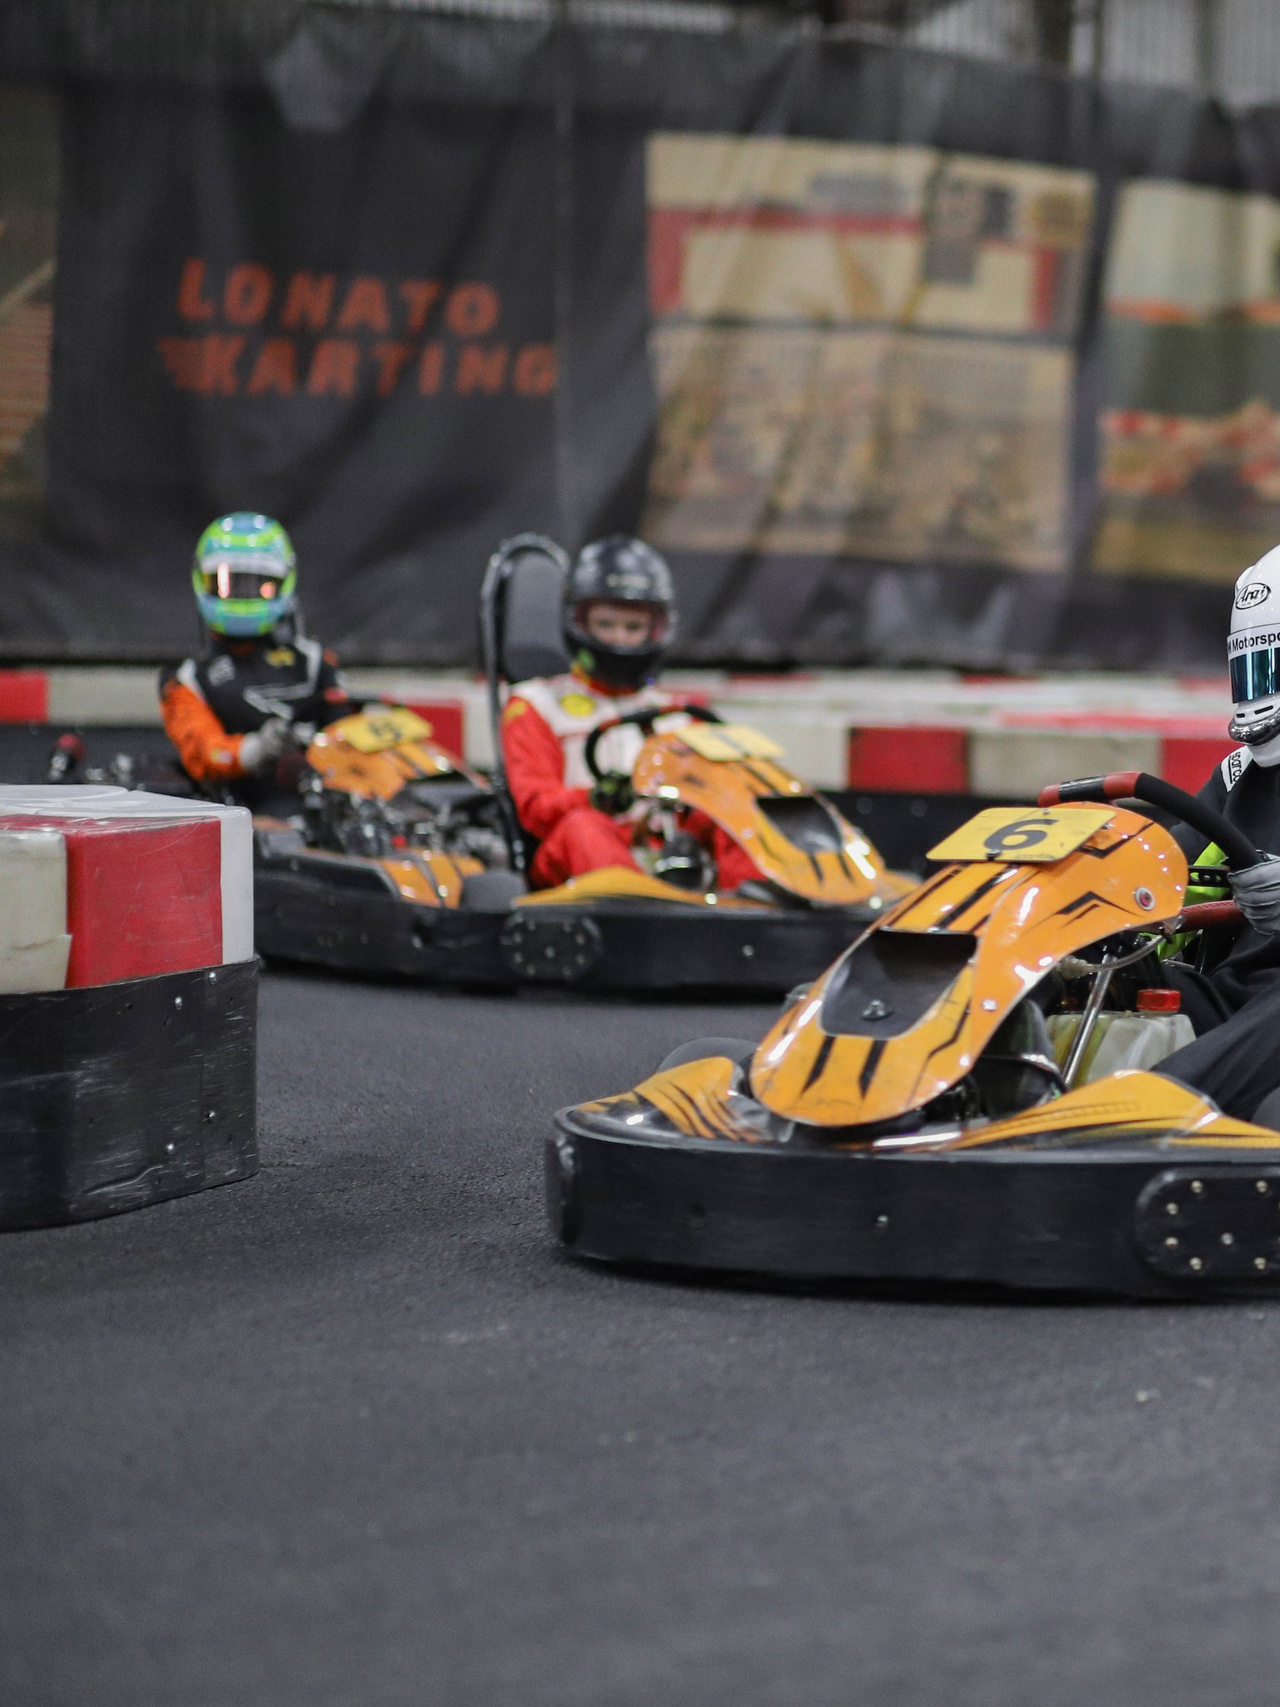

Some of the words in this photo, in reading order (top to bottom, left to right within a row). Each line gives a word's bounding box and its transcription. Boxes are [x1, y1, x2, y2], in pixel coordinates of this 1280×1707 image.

[176, 258, 500, 337] LONATO
[180, 331, 562, 396] KARTING
[1239, 584, 1267, 602] Arai
[983, 818, 1060, 851] 6
